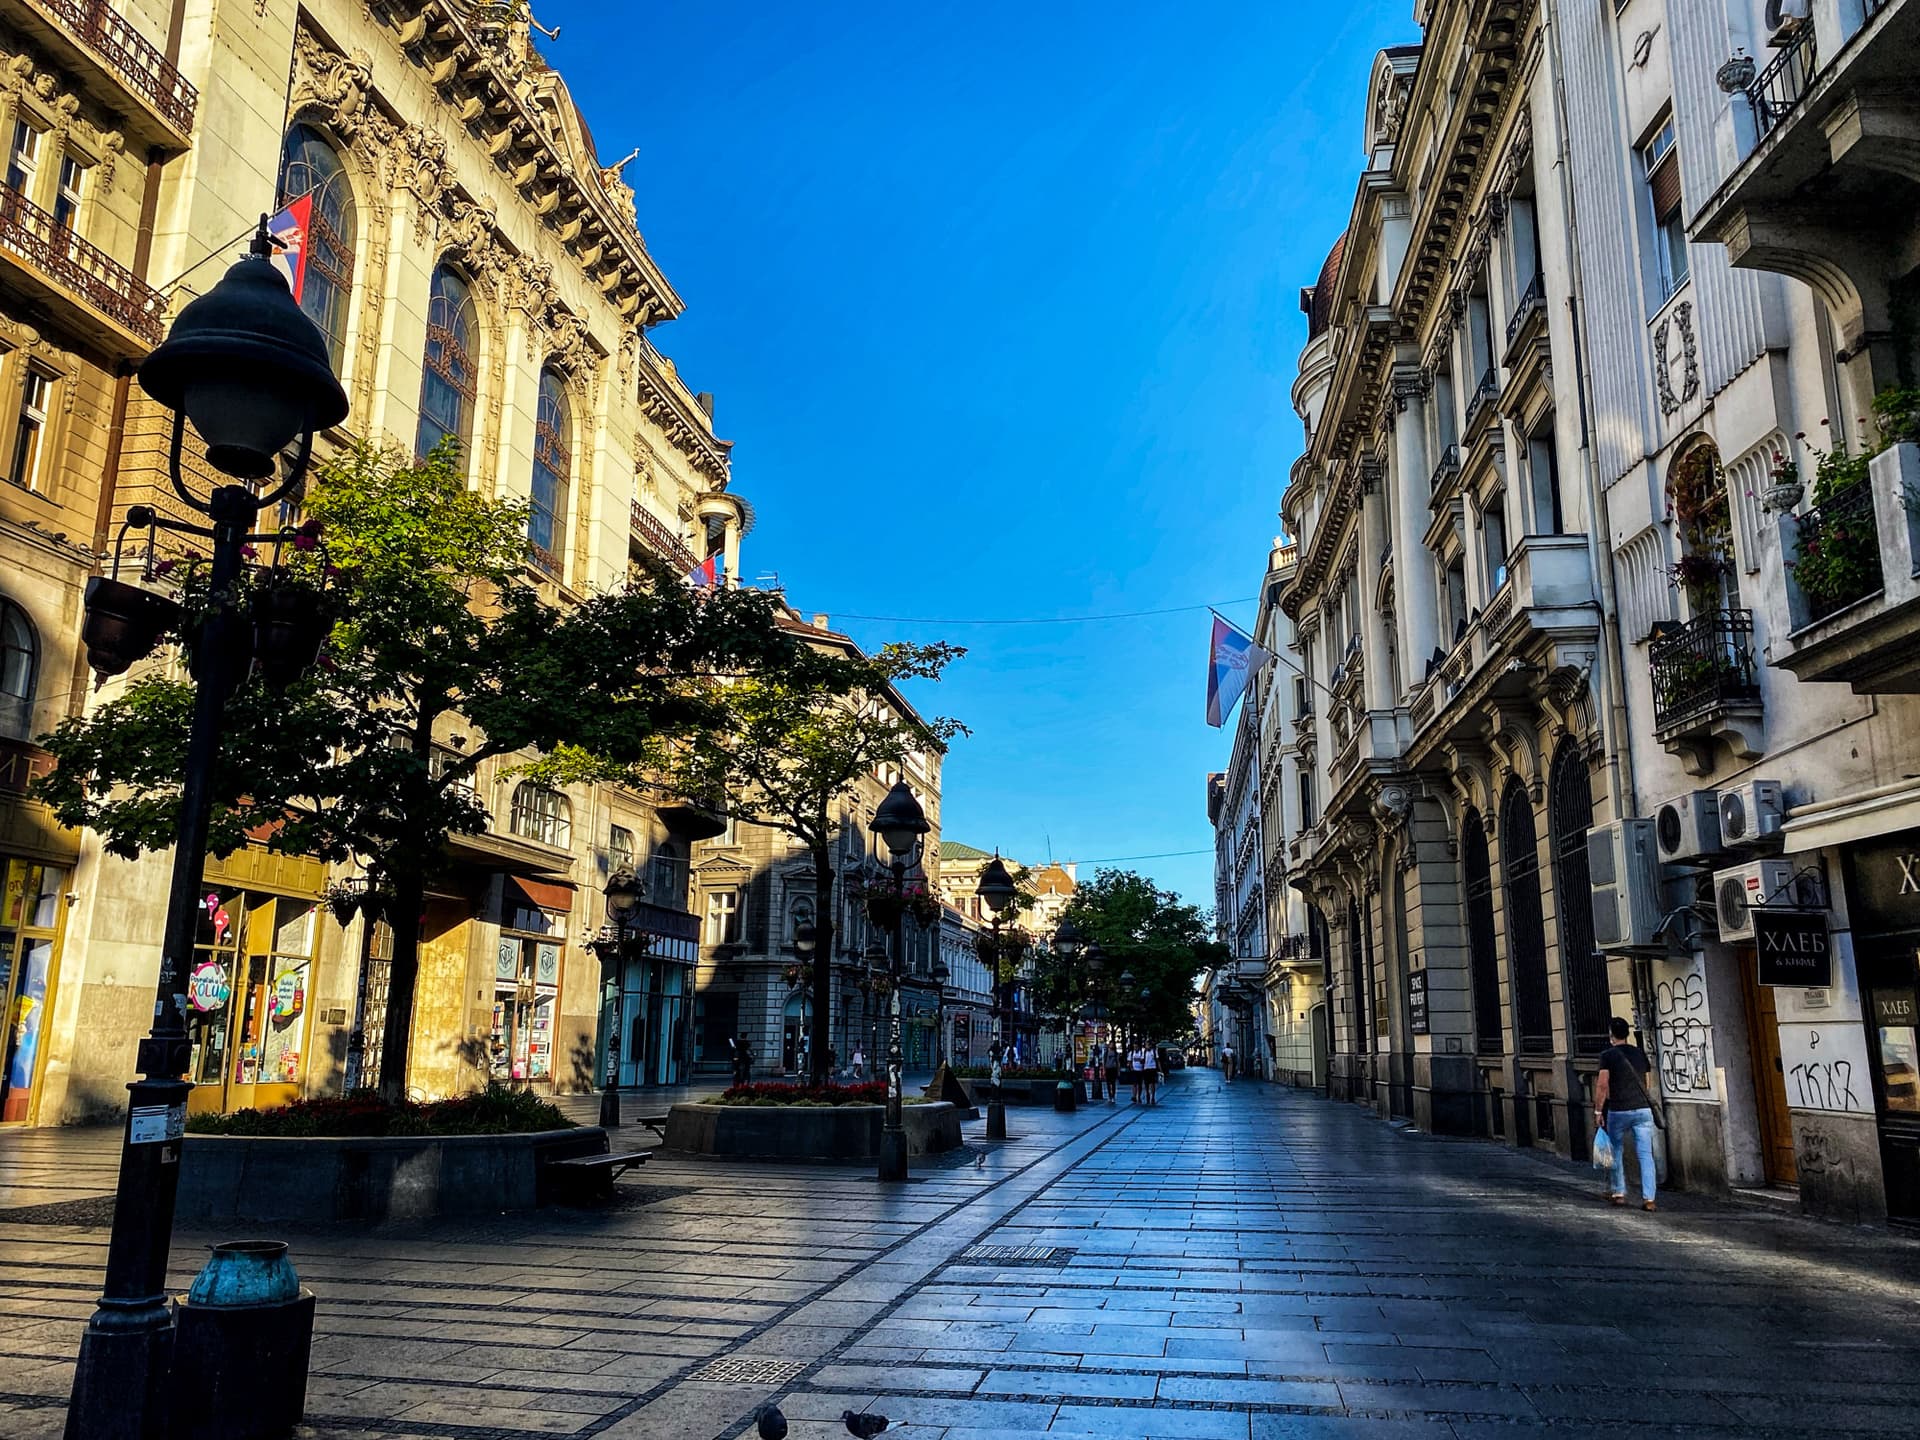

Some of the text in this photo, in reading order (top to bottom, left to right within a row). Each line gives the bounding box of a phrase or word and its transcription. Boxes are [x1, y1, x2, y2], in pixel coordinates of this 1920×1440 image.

[1895, 853, 1920, 895] Х
[1764, 931, 1825, 953] ХЛЕБ
[1882, 1000, 1911, 1015] ХЛЕБ
